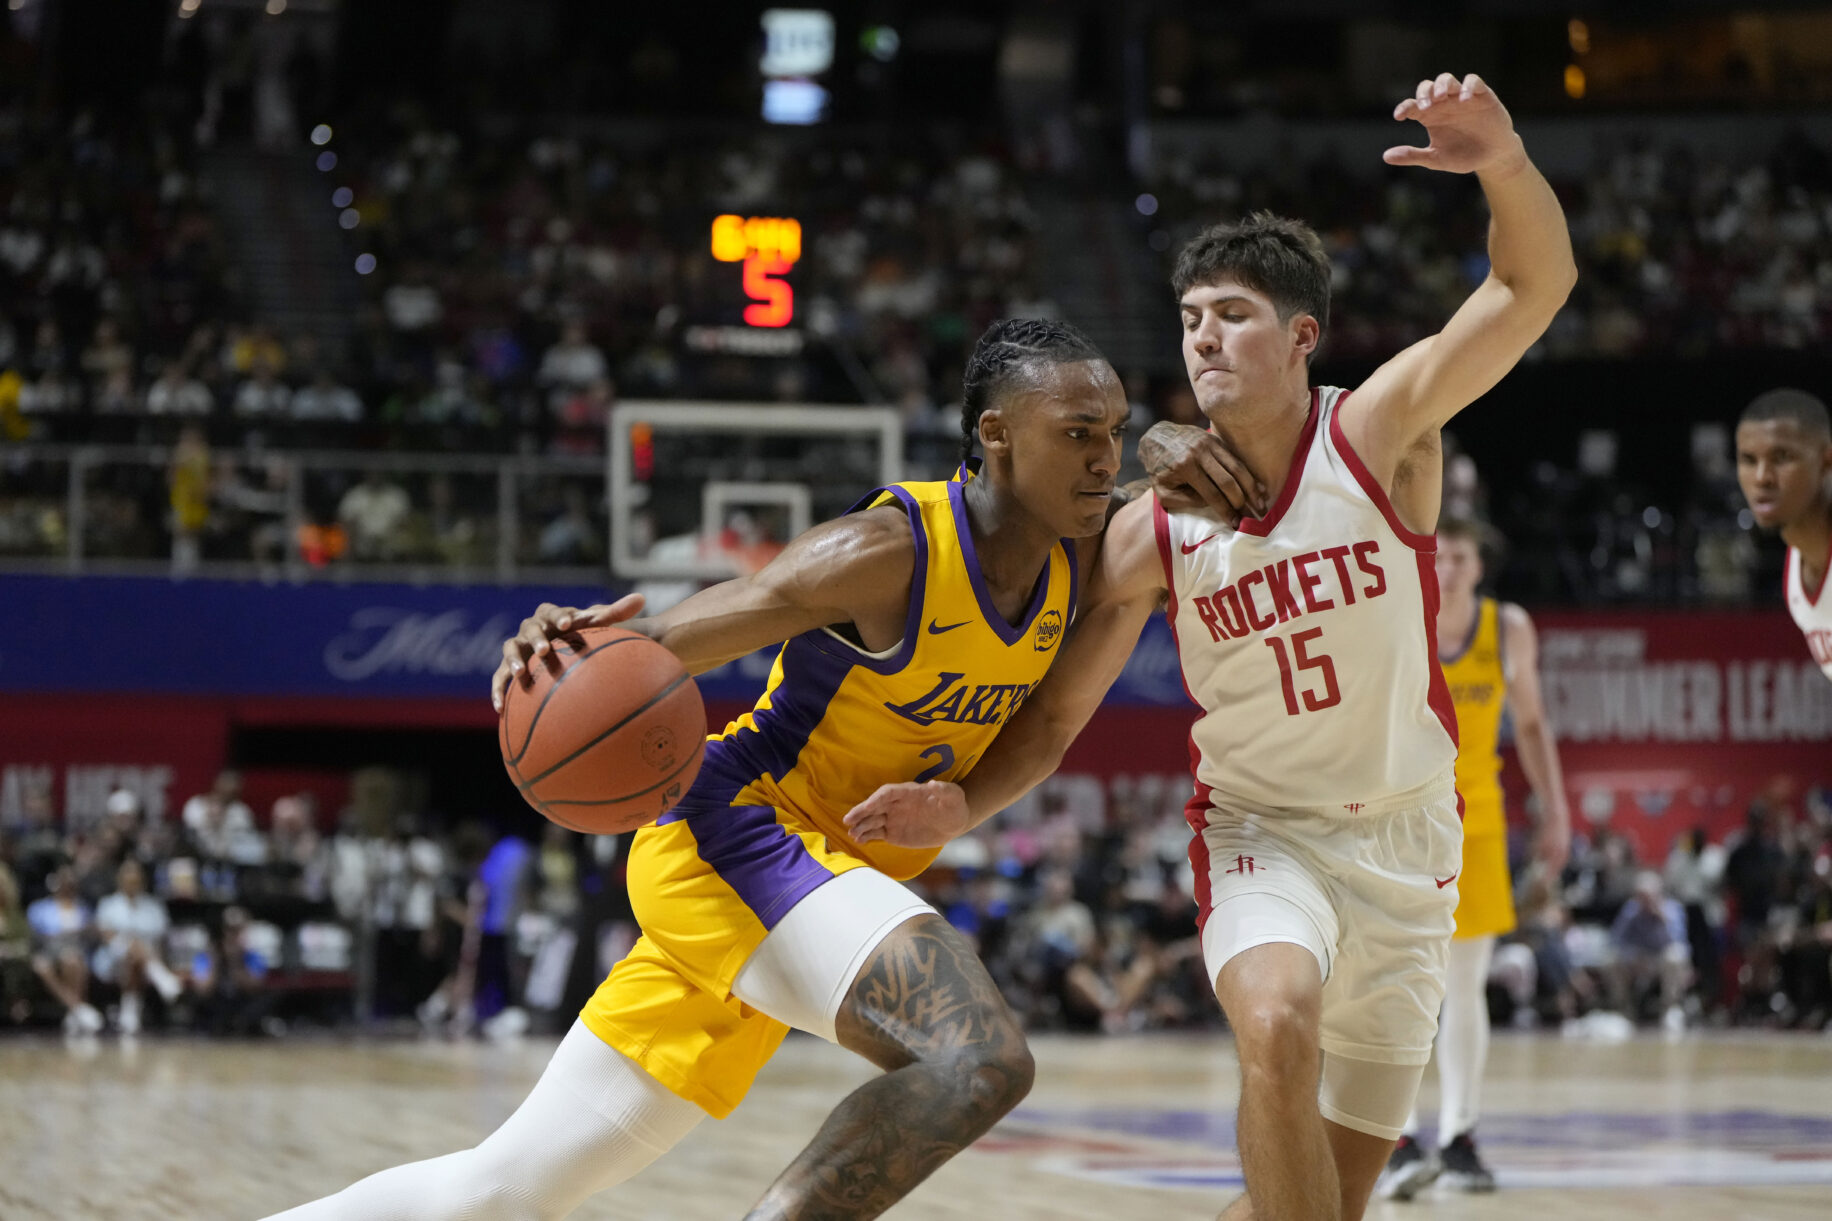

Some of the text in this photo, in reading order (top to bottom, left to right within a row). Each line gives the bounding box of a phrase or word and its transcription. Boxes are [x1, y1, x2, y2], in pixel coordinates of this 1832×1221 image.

[742, 254, 794, 328] 5
[1036, 621, 1060, 639] bibigo
[1192, 540, 1387, 643] ROCKETS
[883, 671, 1040, 727] LAKER
[1264, 626, 1341, 716] 15
[1727, 661, 1832, 742] LEAG
